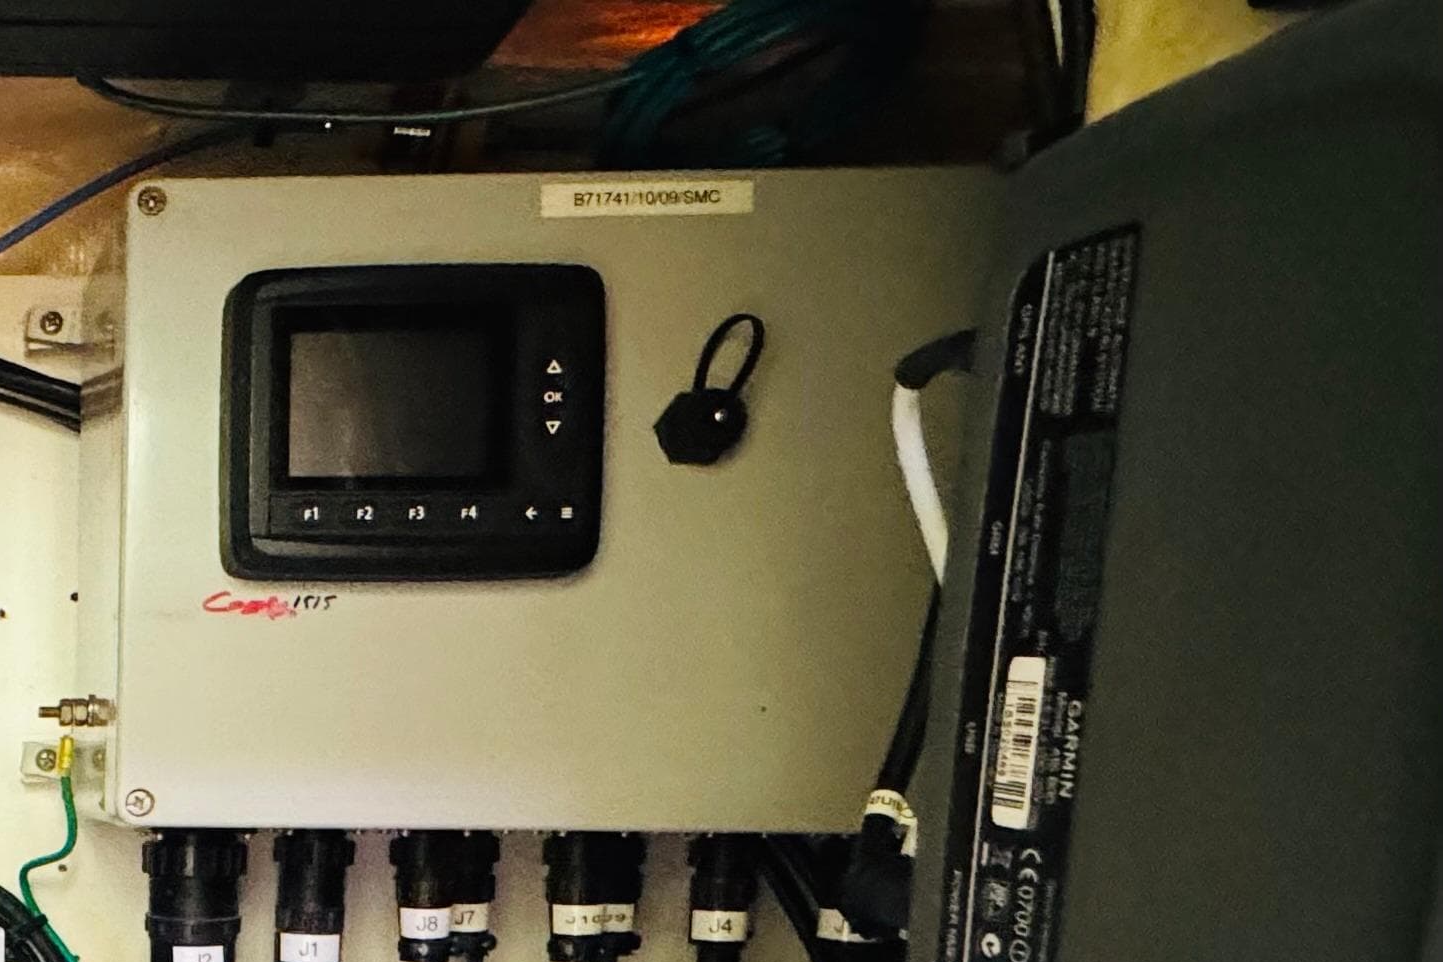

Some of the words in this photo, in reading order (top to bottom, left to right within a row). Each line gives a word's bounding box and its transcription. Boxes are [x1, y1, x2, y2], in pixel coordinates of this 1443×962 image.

[543, 390, 563, 404] OK
[303, 506, 320, 520] F1
[356, 506, 374, 520] F2
[408, 505, 426, 520] F3
[460, 505, 478, 519] F4
[1058, 699, 1082, 798] GARMIN
[454, 910, 475, 926] J7
[1014, 886, 1036, 936] 0700
[415, 915, 439, 932] J8
[707, 917, 732, 934] J4
[298, 942, 318, 958] J1
